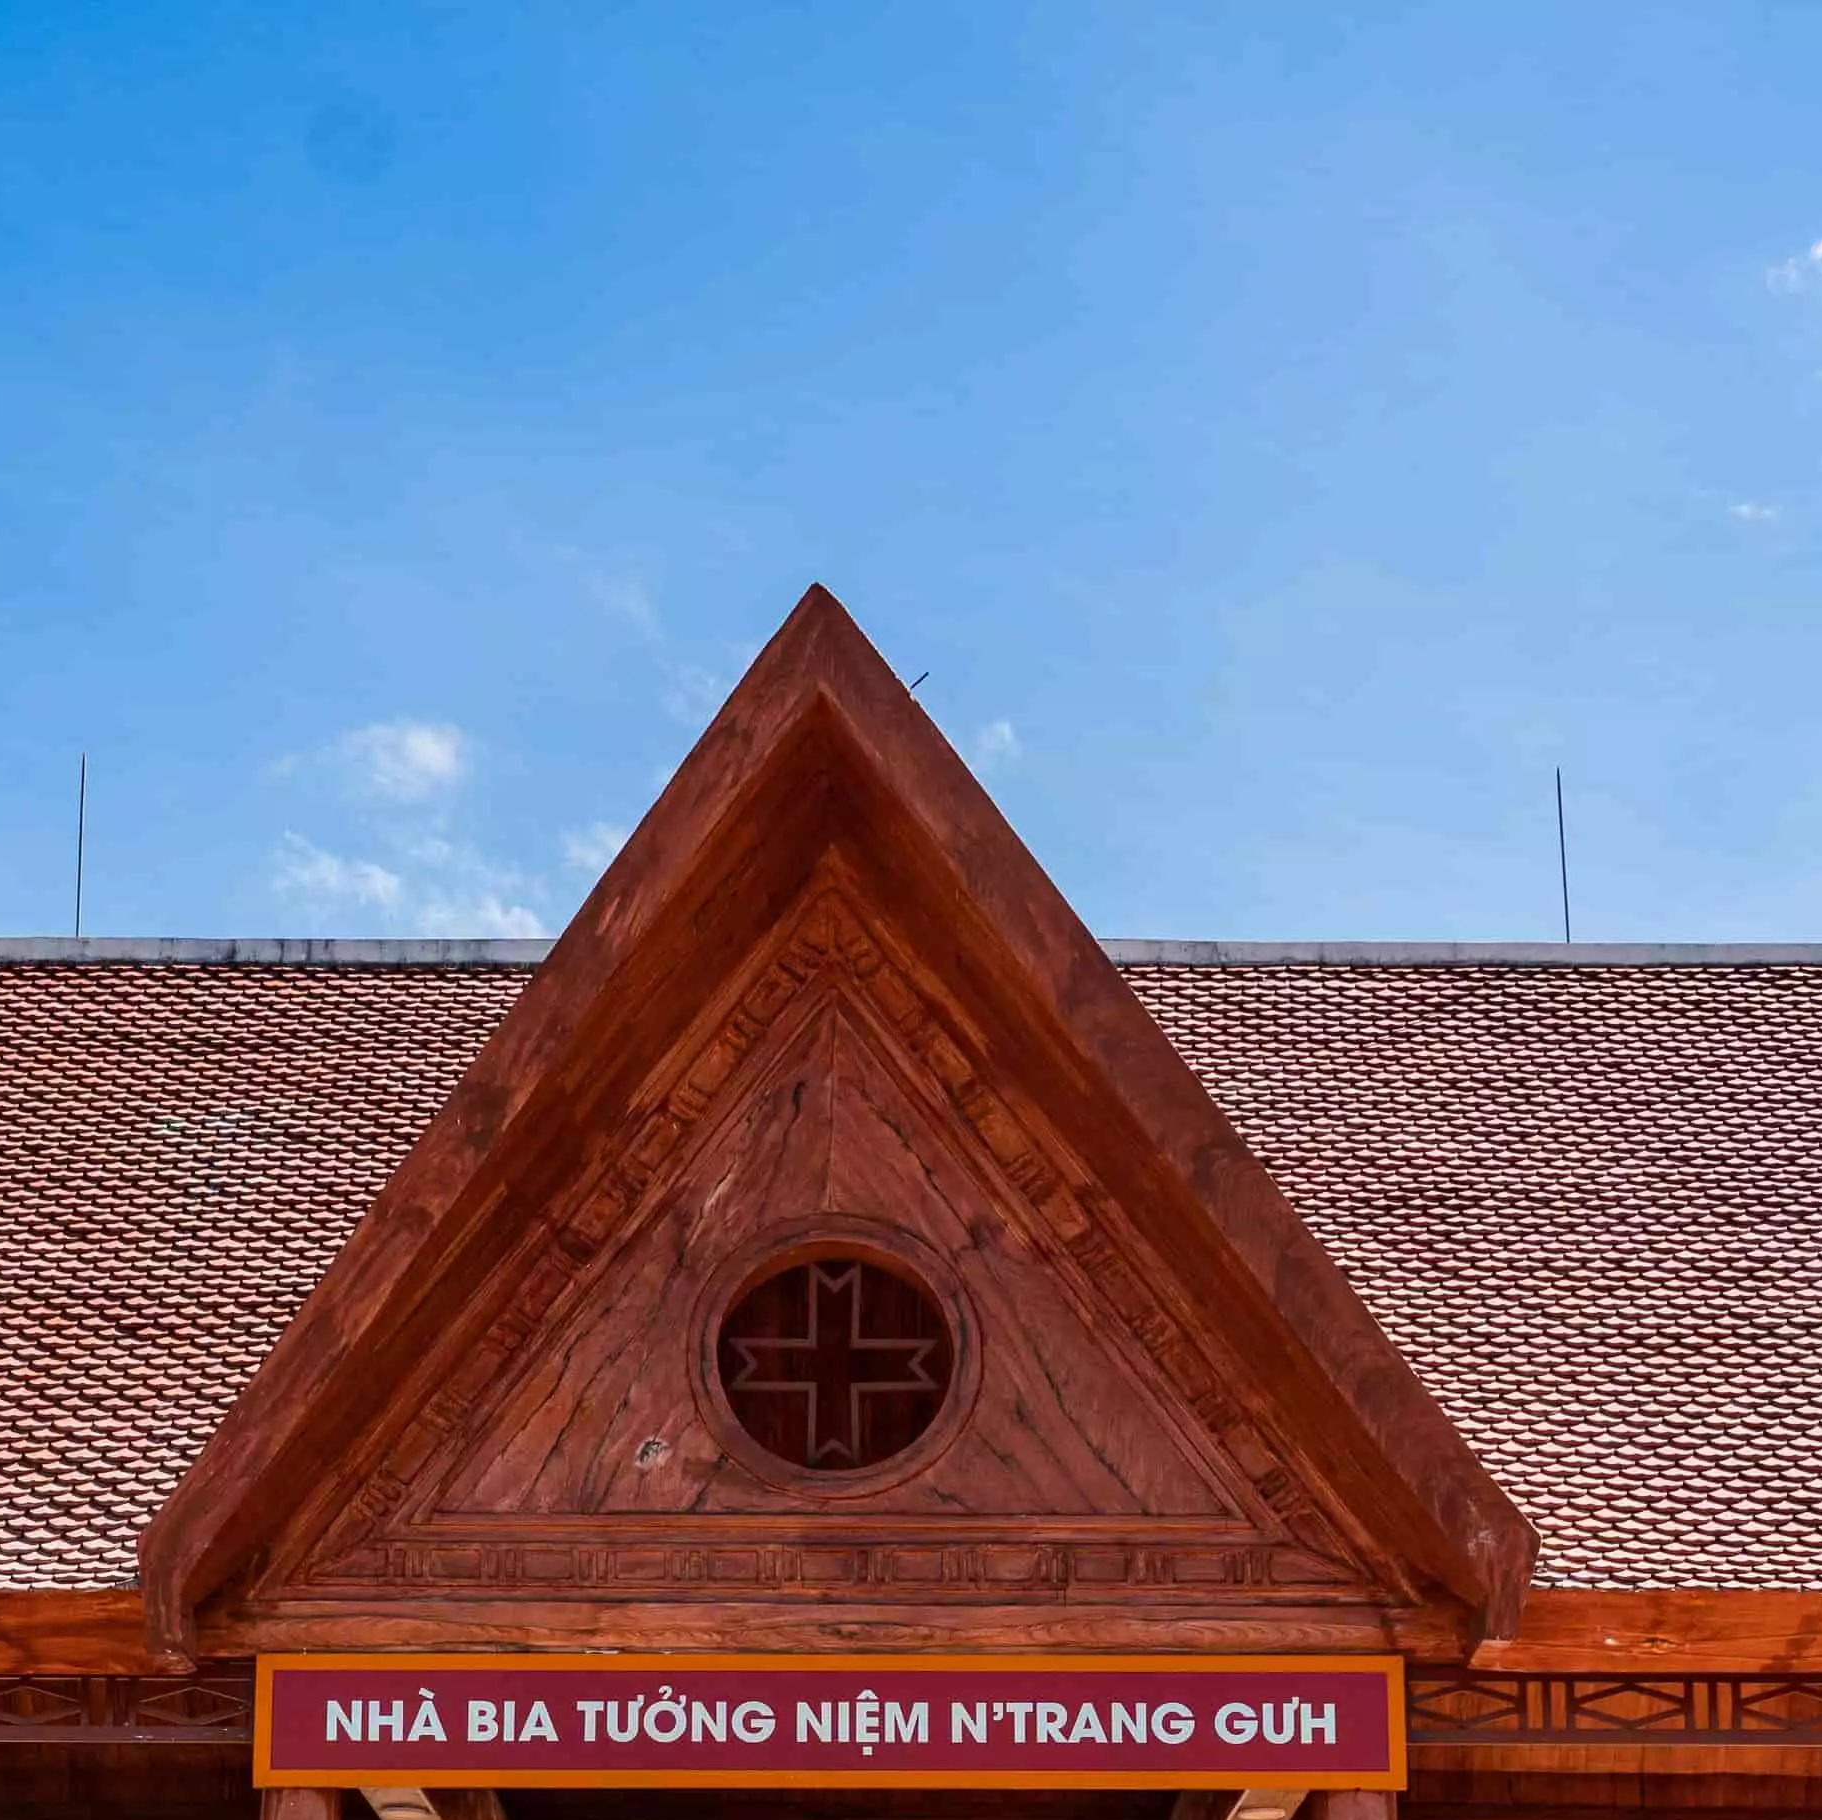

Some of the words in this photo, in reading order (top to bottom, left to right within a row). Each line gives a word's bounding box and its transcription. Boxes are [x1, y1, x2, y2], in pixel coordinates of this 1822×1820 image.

[326, 1687, 448, 1742] NHÀ
[467, 1700, 559, 1742] BIA
[576, 1685, 776, 1743] TƯỞNG
[796, 1689, 929, 1756] NIỆM
[951, 1702, 1196, 1745] N'TRANG
[1214, 1696, 1336, 1745] GƯH
